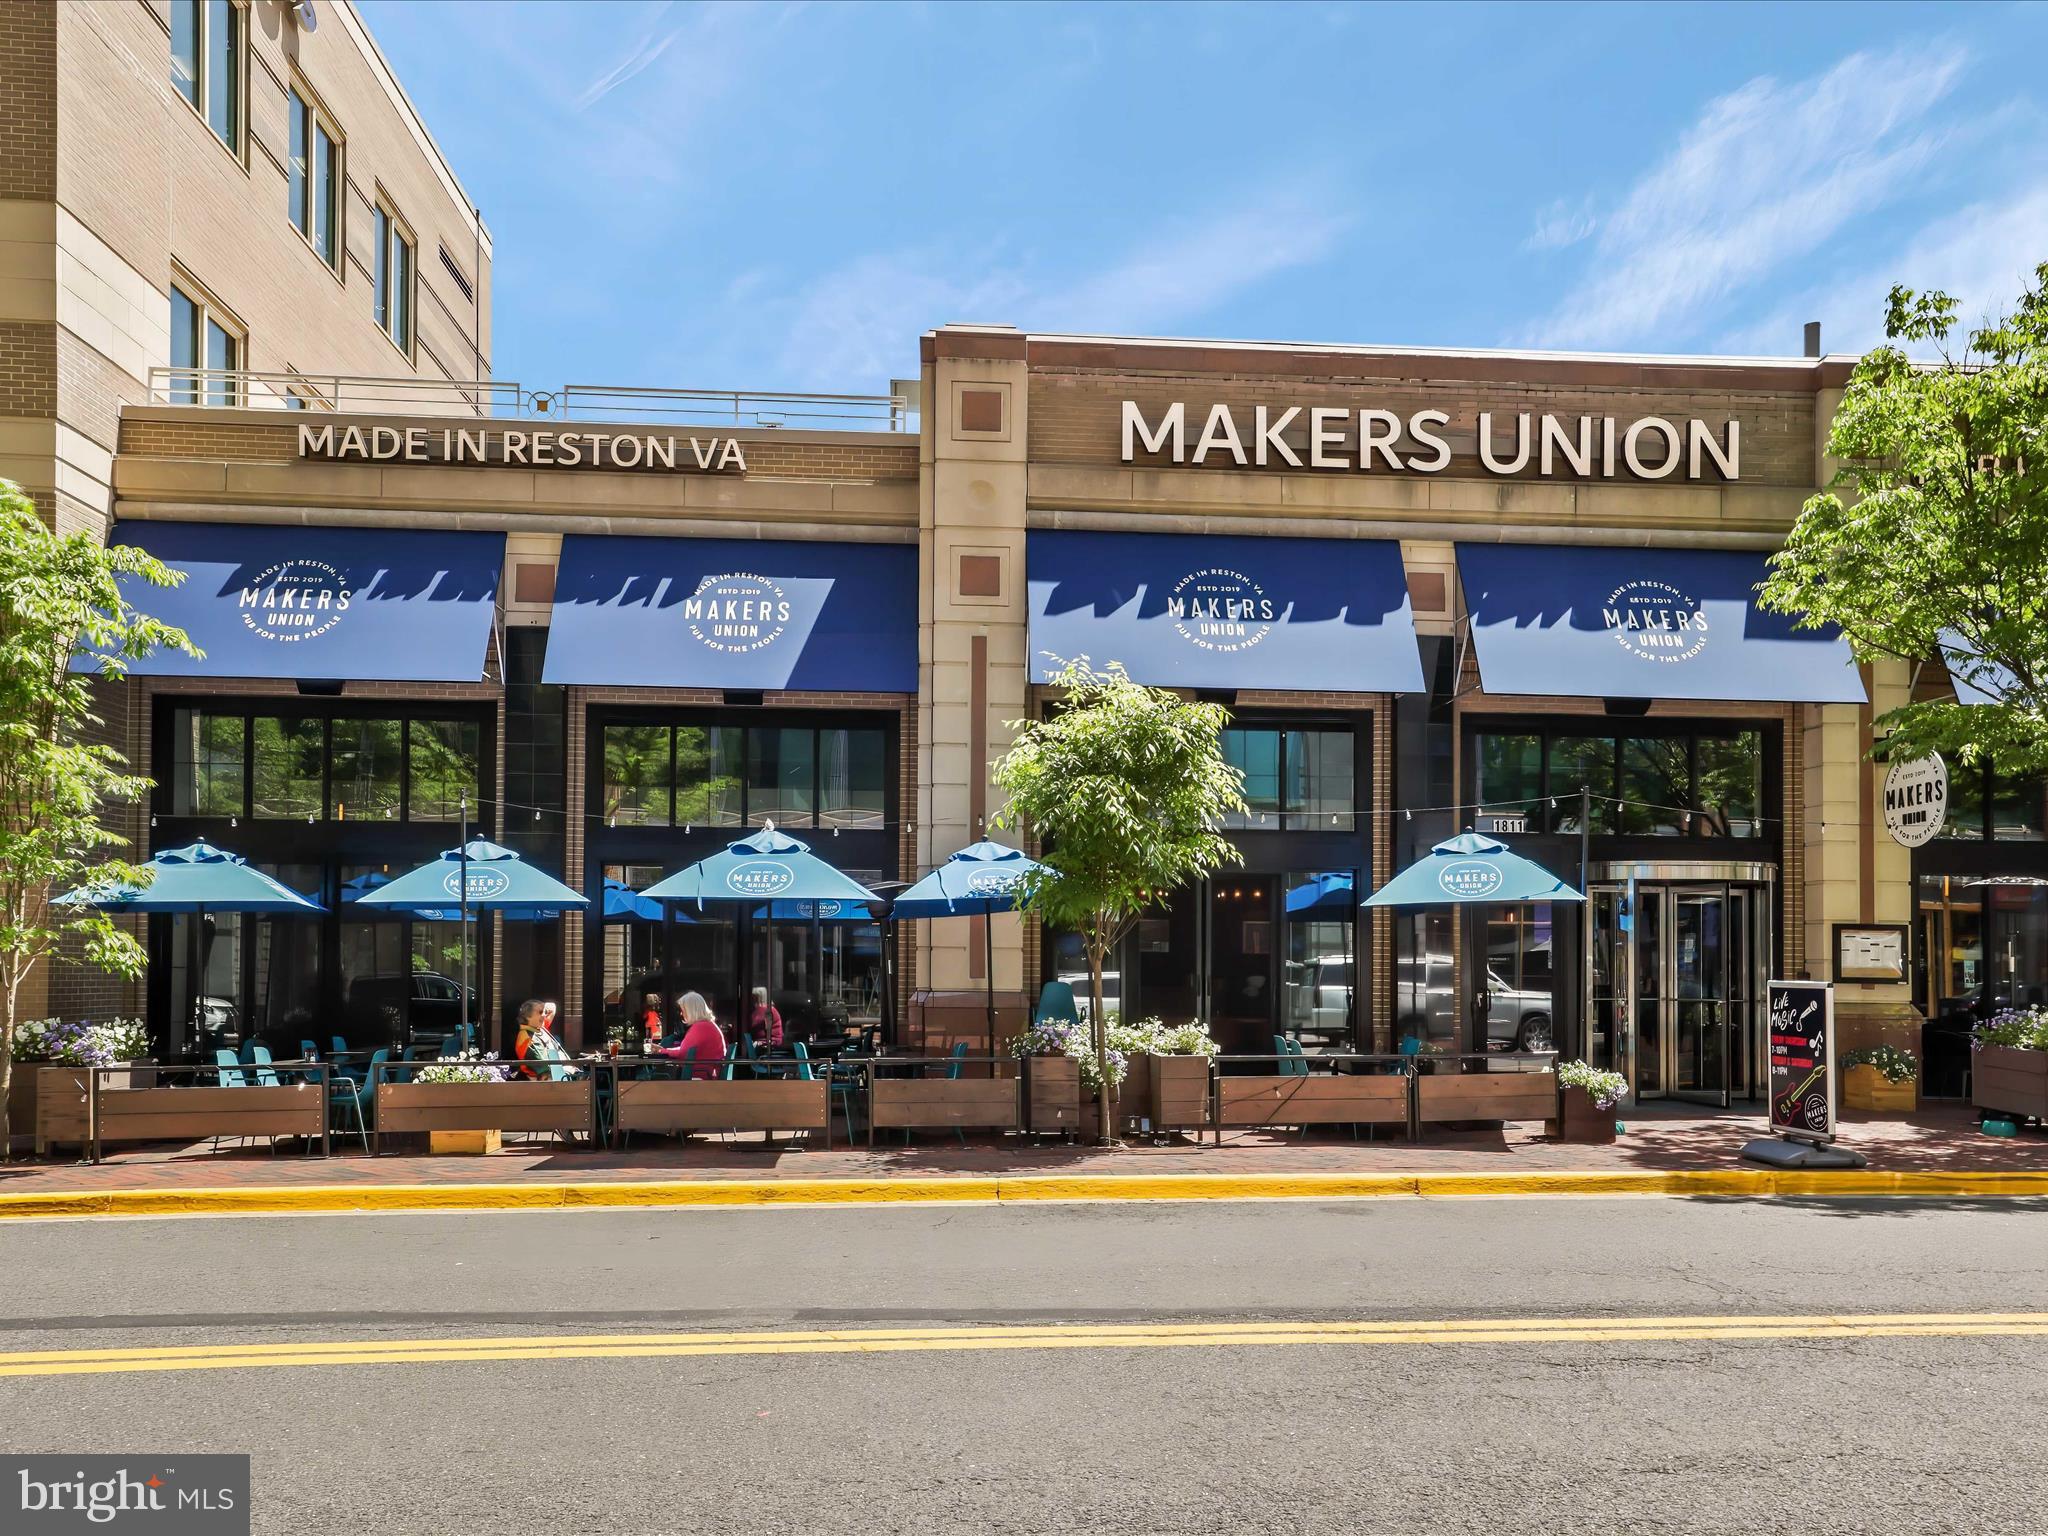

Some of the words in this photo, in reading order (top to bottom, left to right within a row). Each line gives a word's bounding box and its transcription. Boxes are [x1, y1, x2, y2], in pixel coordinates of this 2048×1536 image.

[298, 423, 429, 461] MADE
[443, 428, 487, 462] IN
[503, 430, 676, 468] RESTON
[689, 436, 748, 471] VA
[1121, 400, 1452, 472] MAKERS
[1479, 411, 1740, 480] UNION
[253, 565, 280, 584] MADE
[283, 560, 294, 568] IN
[298, 559, 337, 576] RESTON,
[338, 575, 347, 586] VA
[1174, 574, 1195, 593] MADE
[1210, 568, 1251, 586] RESTON,
[1253, 584, 1264, 596] VA
[694, 577, 718, 596] MADE
[734, 572, 773, 589] RESTON,
[774, 587, 784, 598] VA
[1607, 585, 1627, 606] MADE
[1626, 581, 1638, 589] IN
[1640, 581, 1681, 598] RESTON,
[1684, 595, 1695, 608] VA
[239, 587, 351, 610] MAKERS
[1167, 597, 1274, 620] MAKERS
[267, 613, 315, 626] UNION
[685, 600, 790, 622] MAKERS
[1602, 608, 1708, 631] MAKERS
[242, 613, 257, 629] PUB
[255, 628, 276, 640] FOR
[304, 615, 341, 639] PEOPLE
[689, 624, 704, 640] PUB
[703, 639, 724, 651] FOR
[751, 626, 785, 650] PEOPLE
[714, 624, 758, 637] UNION
[1174, 623, 1192, 639] PUB
[1192, 638, 1213, 650] FOR
[1217, 644, 1239, 652] THE
[1240, 624, 1270, 649] PEOPLE
[1200, 623, 1246, 636] UNION
[1614, 634, 1632, 650] PUB
[1634, 648, 1655, 661] FOR
[1659, 655, 1680, 663] THE
[1681, 636, 1707, 660] PEOPLE
[1639, 633, 1684, 648] UNION
[1885, 779, 1943, 811] MAKERS
[1495, 820, 1523, 832] 1811
[1899, 830, 1910, 840] FOR
[1911, 833, 1922, 841] THE
[1924, 808, 1940, 835] PEOPLE
[1902, 810, 1927, 826] UNION
[450, 879, 503, 887] MKERS
[733, 874, 788, 883] MAKERS
[1444, 873, 1497, 883] MAKERS
